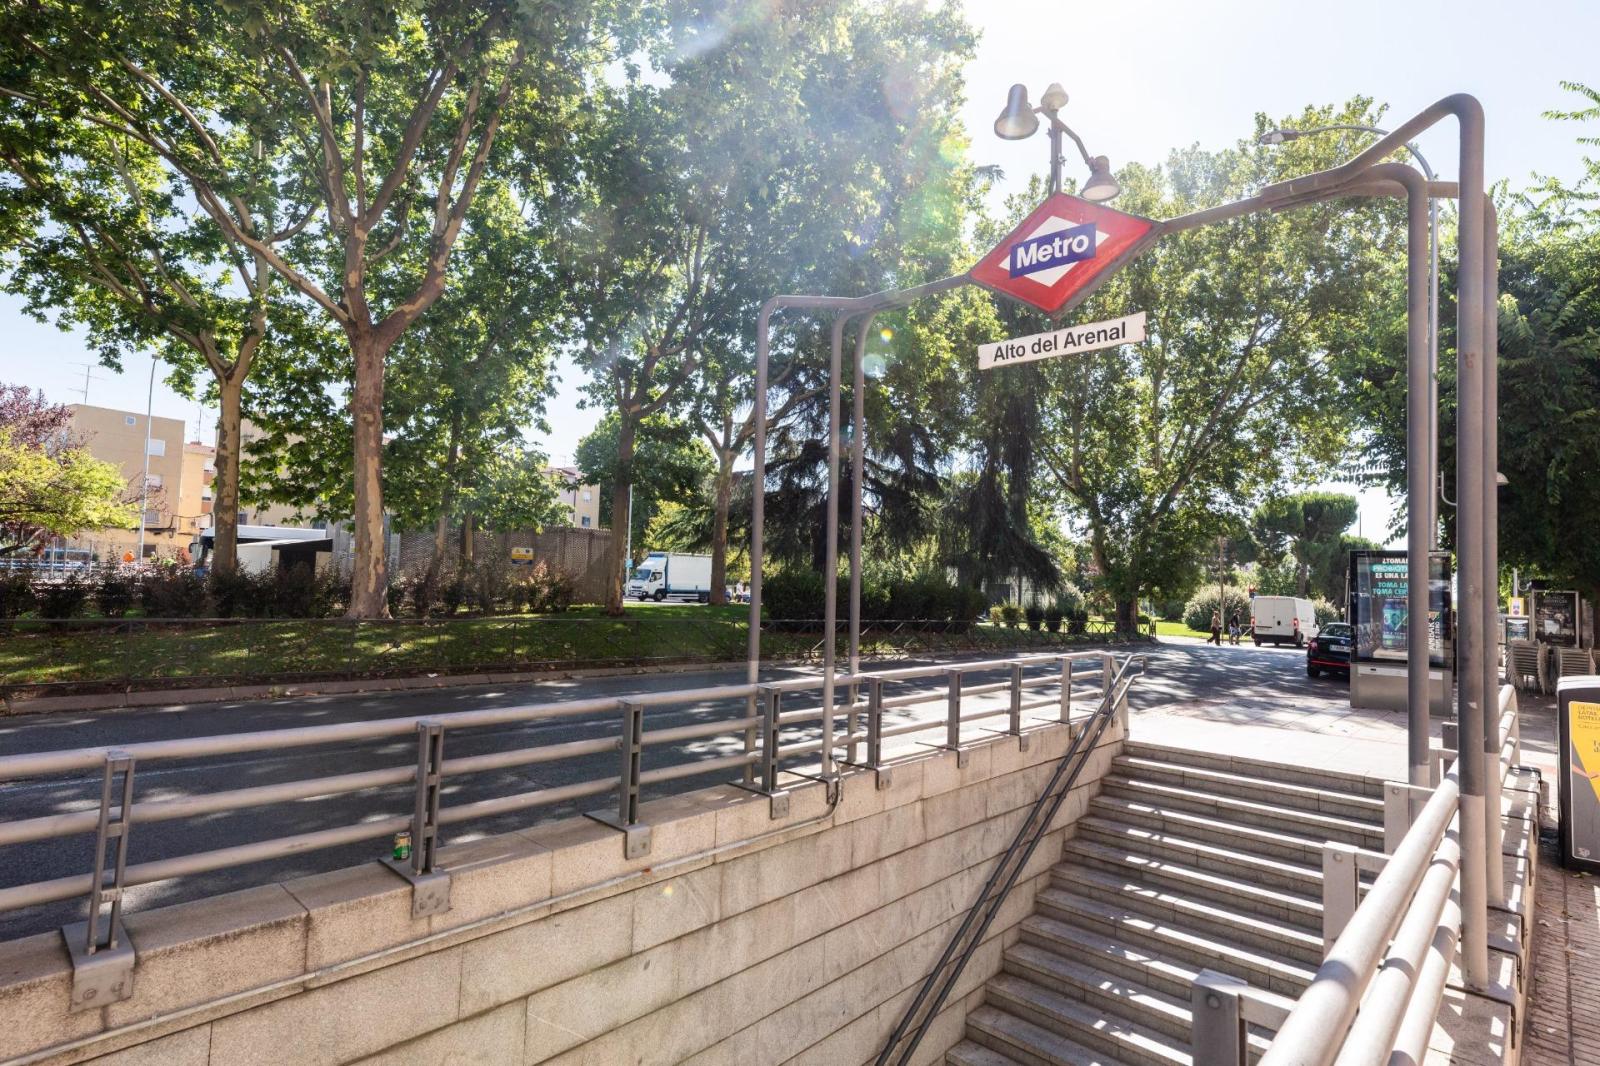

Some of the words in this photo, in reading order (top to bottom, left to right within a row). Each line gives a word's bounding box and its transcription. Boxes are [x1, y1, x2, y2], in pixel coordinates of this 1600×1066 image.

[1017, 235, 1089, 268] Metro
[994, 345, 1026, 362] Alto
[1031, 335, 1058, 354] del
[1064, 322, 1126, 348] Arenal
